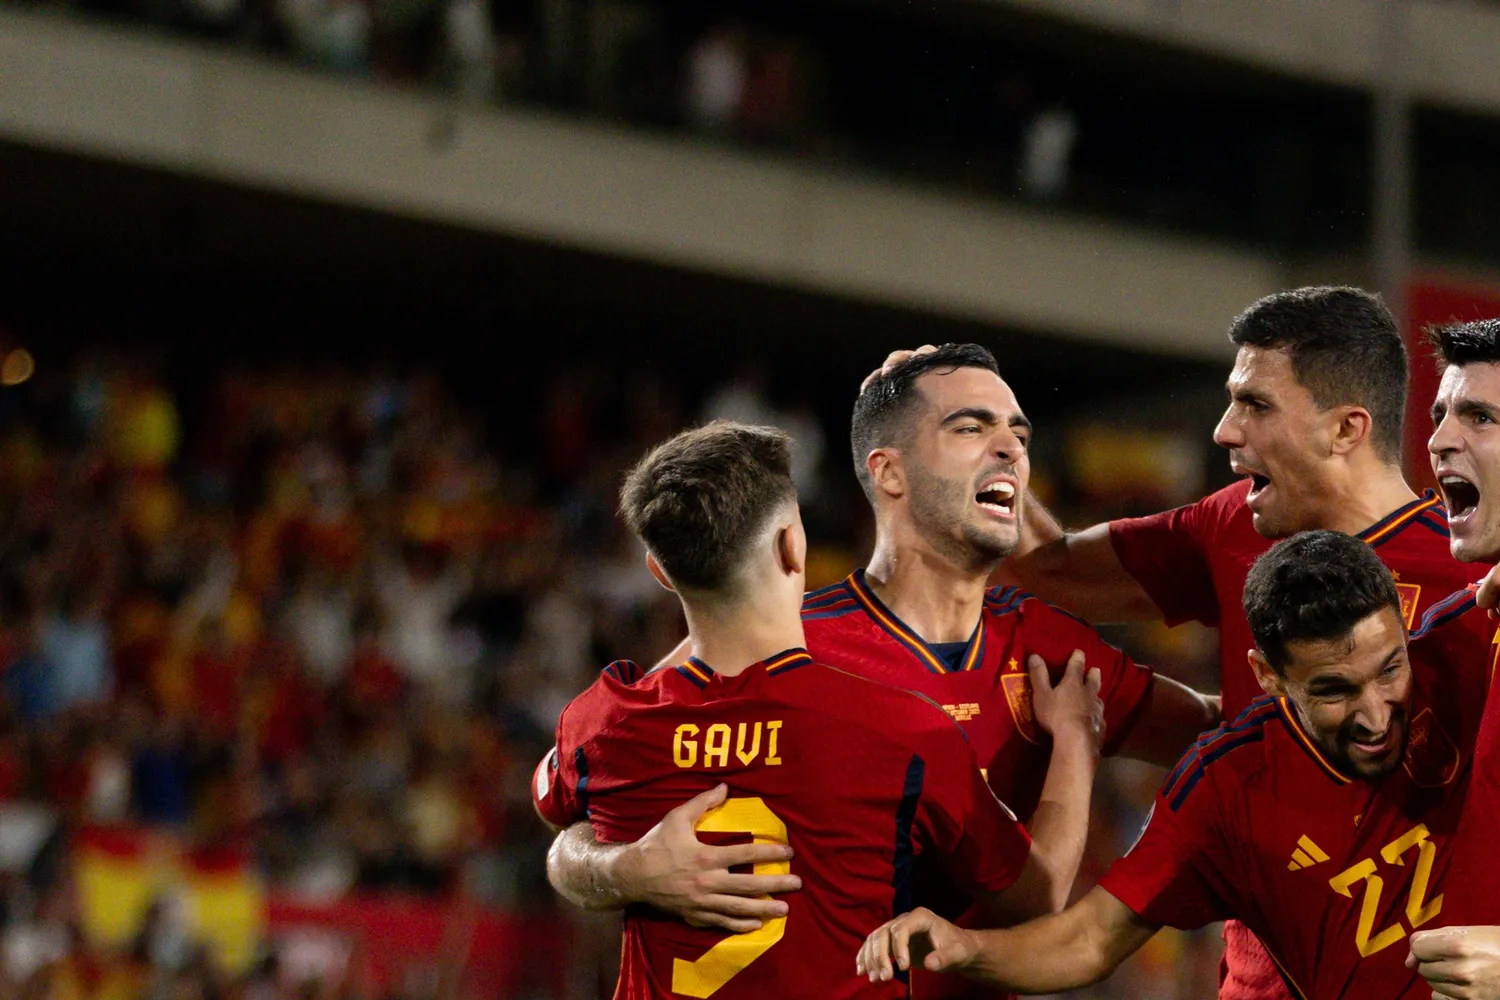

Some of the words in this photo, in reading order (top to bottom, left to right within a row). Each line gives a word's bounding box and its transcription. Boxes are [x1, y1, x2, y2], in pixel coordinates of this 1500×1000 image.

[673, 720, 783, 768] GAVI
[671, 797, 791, 999] 9
[1328, 823, 1444, 958] 22
